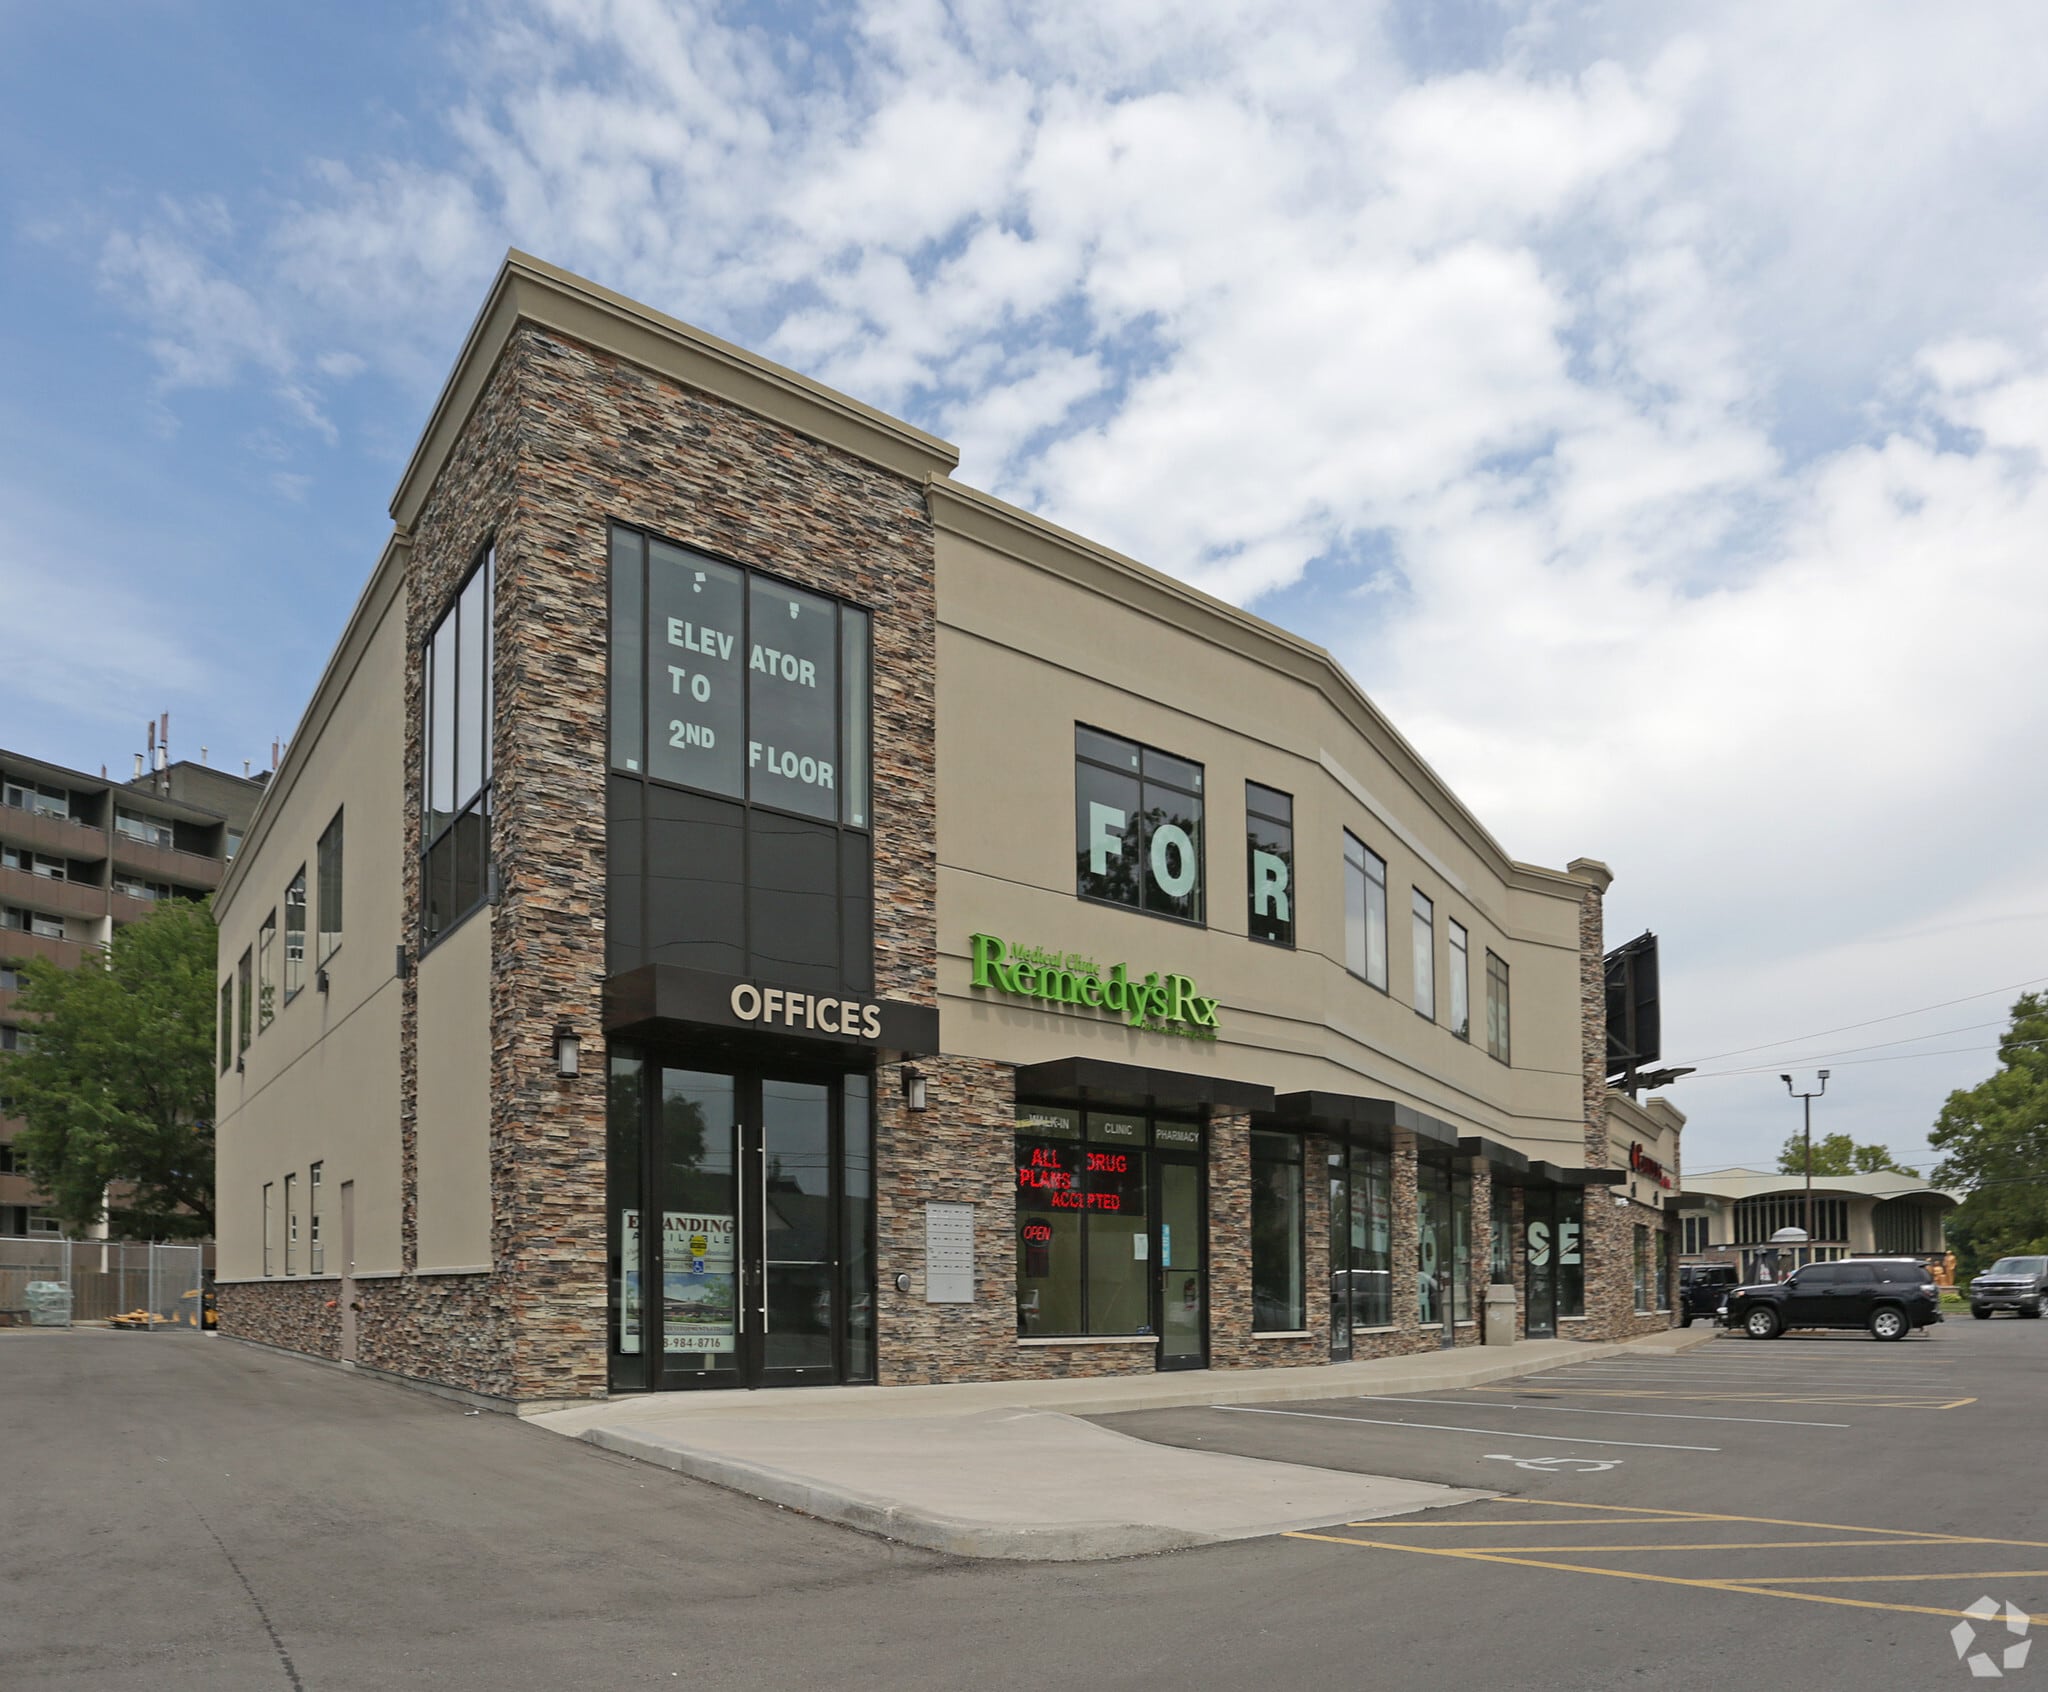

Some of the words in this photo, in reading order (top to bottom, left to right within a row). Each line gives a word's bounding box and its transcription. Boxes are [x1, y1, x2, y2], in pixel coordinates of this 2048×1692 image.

[667, 616, 816, 688] ELEVATOR
[668, 665, 711, 702] TO
[669, 719, 715, 750] 2ND
[748, 741, 834, 789] FLOOR
[730, 984, 882, 1040] OFFICES
[1029, 1114, 1070, 1129] WALK-IN
[1104, 1122, 1133, 1136] CLINIC
[1155, 1128, 1200, 1143] PHARMACY
[1031, 1148, 1061, 1169] ALL
[1086, 1152, 1128, 1173] DRUG
[1019, 1168, 1071, 1190] PLANS
[1023, 1225, 1051, 1241] OPEN
